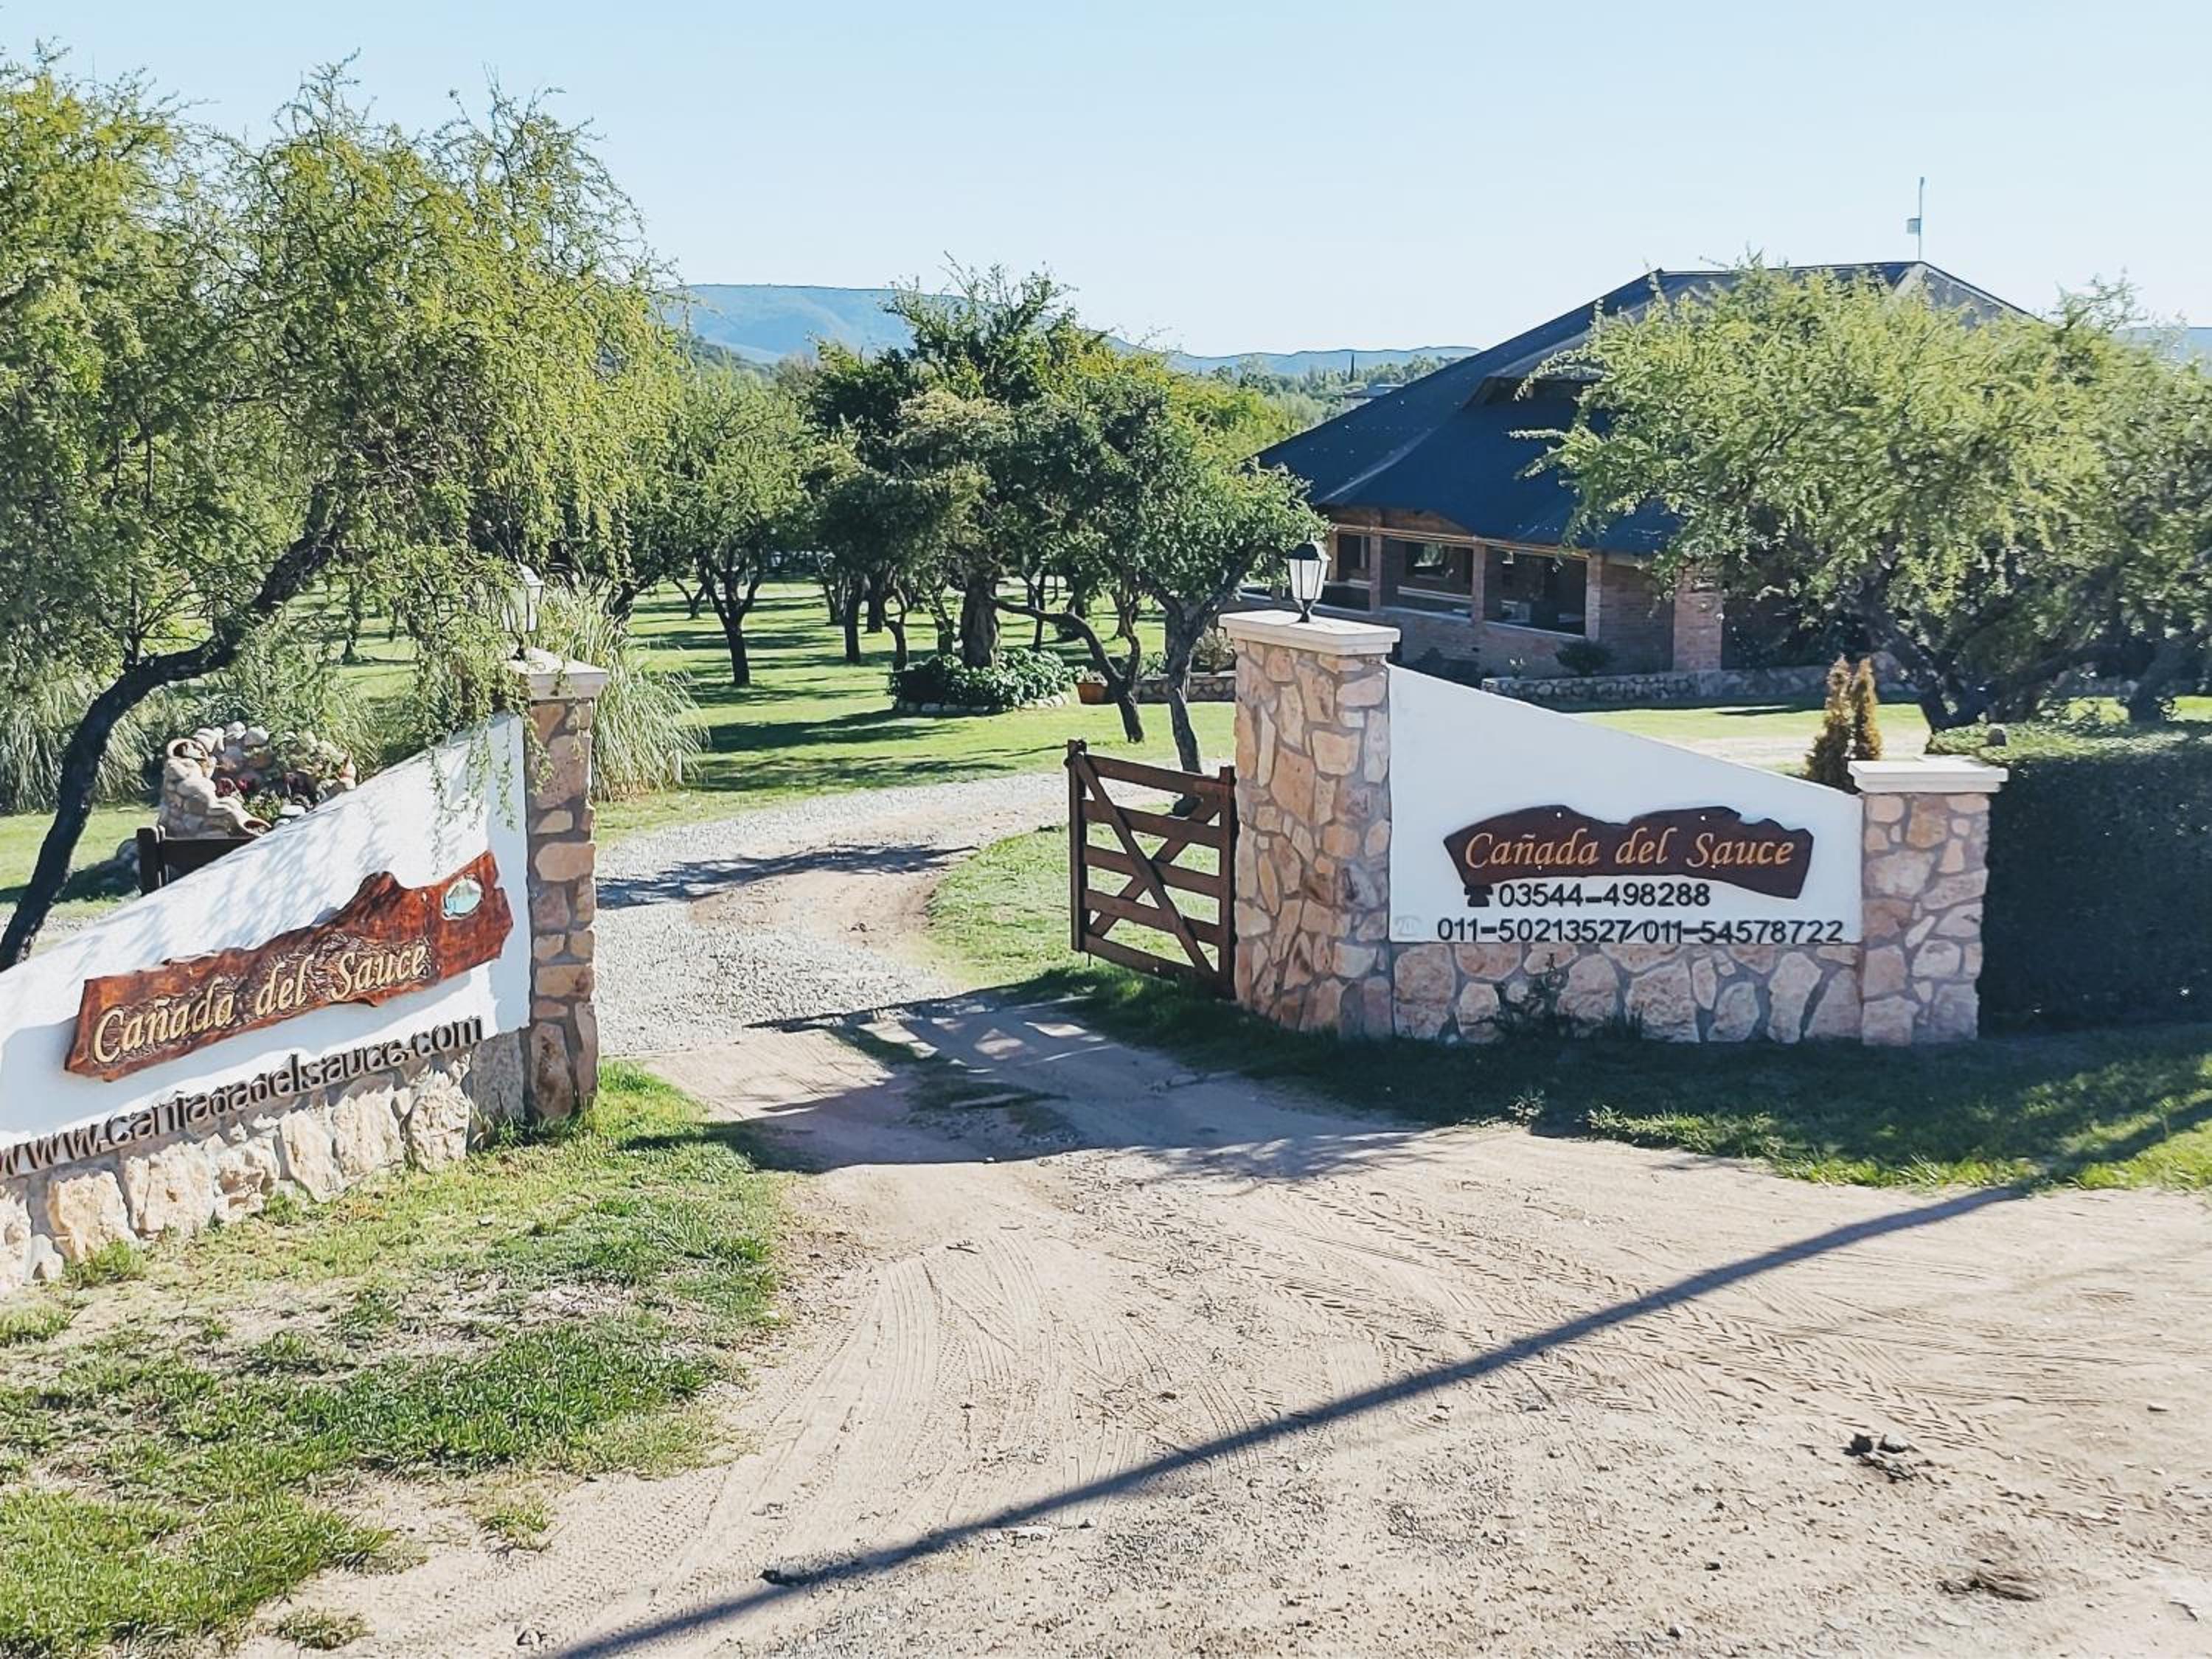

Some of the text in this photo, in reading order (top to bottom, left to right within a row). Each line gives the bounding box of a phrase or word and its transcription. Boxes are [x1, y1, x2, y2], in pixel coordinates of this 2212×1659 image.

[1464, 827, 1795, 869] Cañada del Sauce
[1498, 882, 1711, 908] 03544-498288
[93, 943, 428, 1063] Cañada del Sauce
